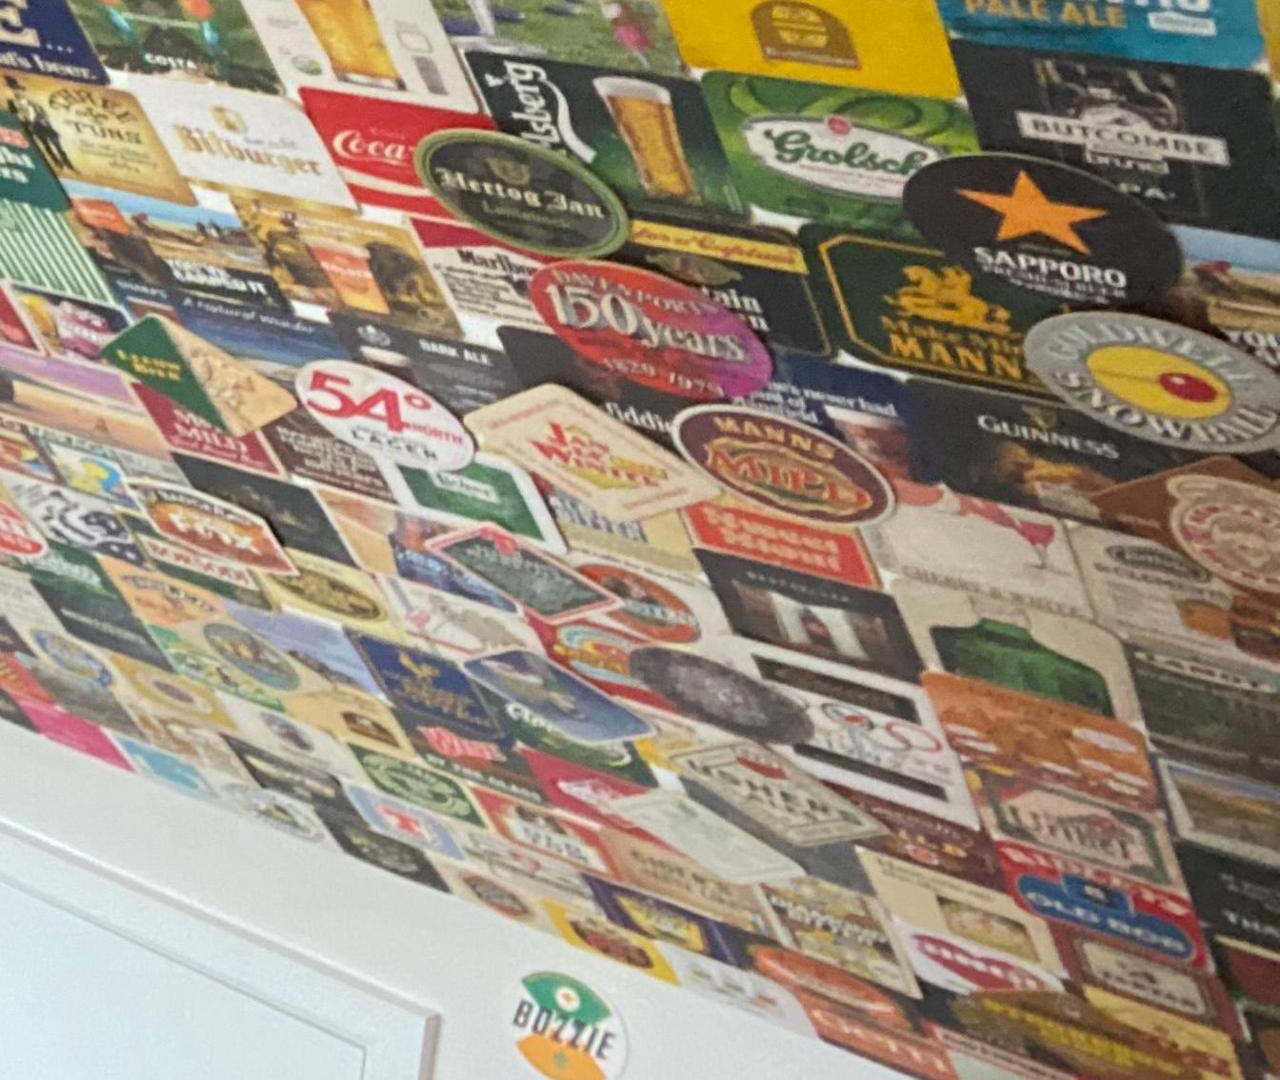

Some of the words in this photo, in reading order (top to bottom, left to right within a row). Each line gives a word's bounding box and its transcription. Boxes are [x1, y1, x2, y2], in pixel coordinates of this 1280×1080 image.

[1061, 1, 1128, 28] ALE
[175, 121, 322, 178] Bitburger
[1031, 118, 1217, 159] BUTCOMBE
[436, 166, 542, 208] Hertog
[544, 189, 607, 220] Jan
[973, 245, 1128, 289] SAPPORO
[544, 283, 638, 336] 150
[642, 316, 746, 363] years
[411, 421, 464, 445] NORTH
[976, 413, 1121, 460] GUINNESS
[513, 998, 617, 1062] BOZZIE
